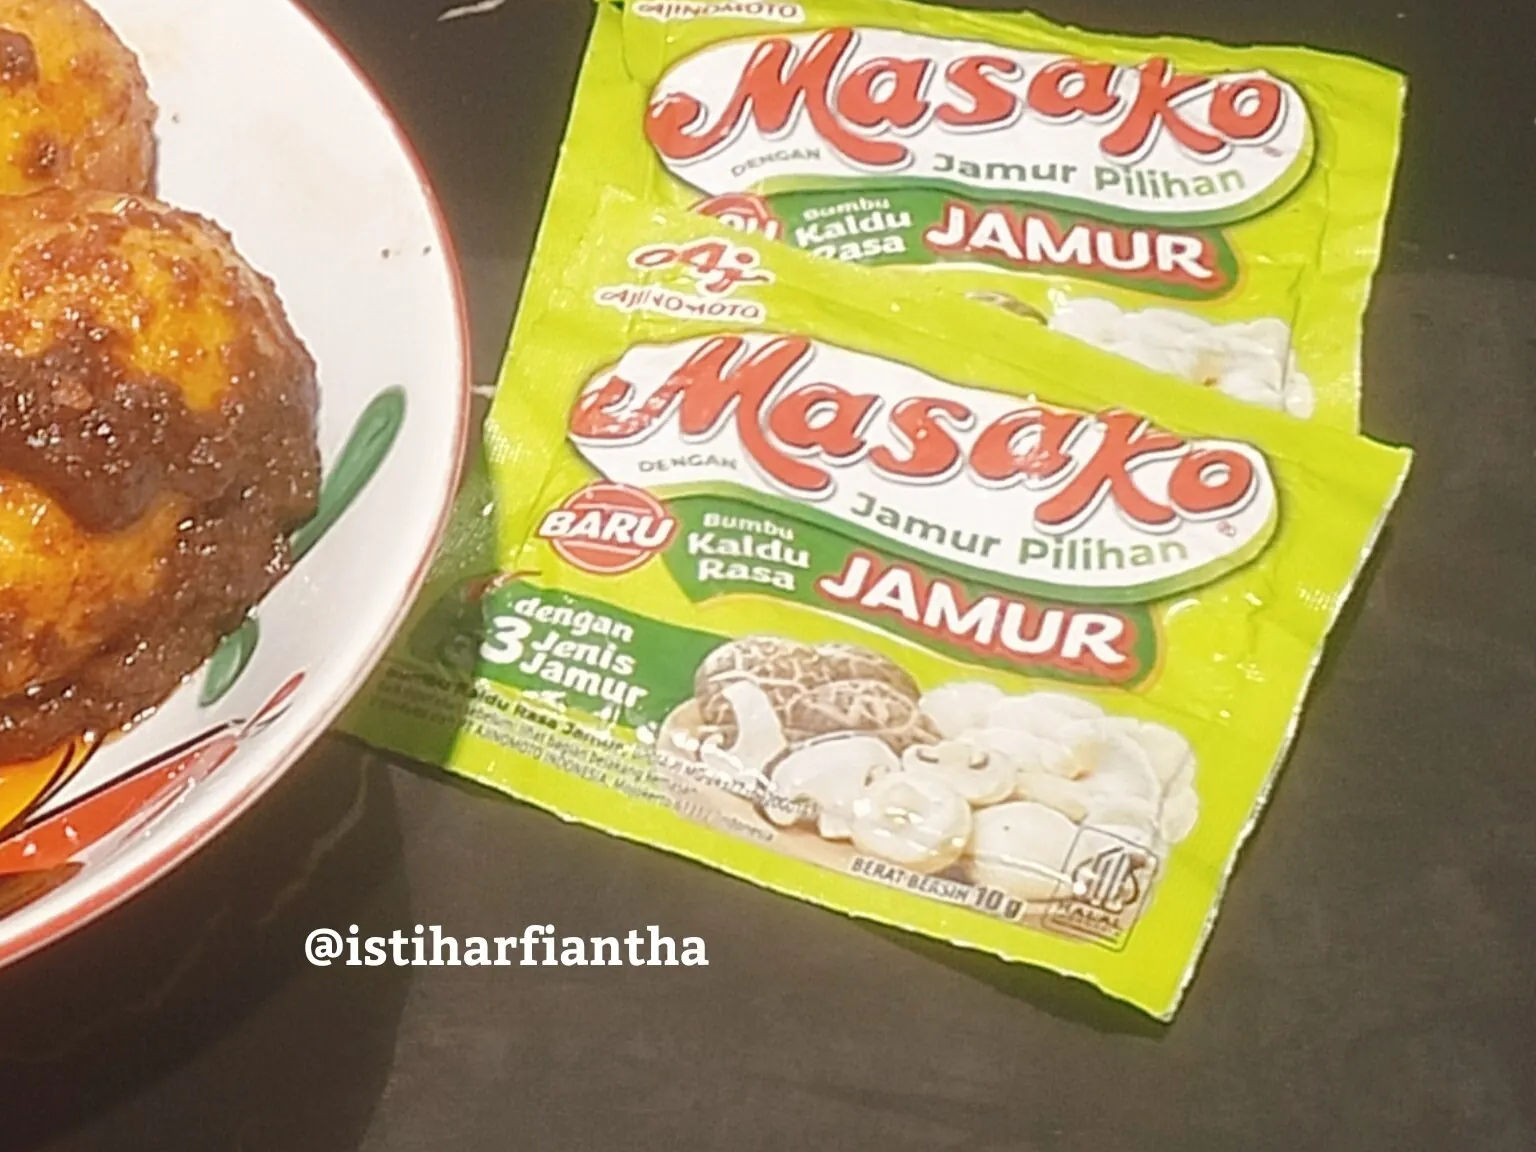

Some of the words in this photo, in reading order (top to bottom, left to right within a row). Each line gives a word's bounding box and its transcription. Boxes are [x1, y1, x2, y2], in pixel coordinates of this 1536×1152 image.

[645, 25, 1283, 167] Masako
[730, 148, 822, 178] DENGAN
[932, 151, 1078, 183] Jamur
[1094, 164, 1246, 200] Pilihan
[794, 210, 913, 247] Kaldu
[925, 204, 1214, 279] JAMUR
[600, 288, 760, 319] AJINOMOTO
[568, 334, 1255, 526] Masako
[638, 454, 739, 474] DENGAN
[538, 510, 675, 548] BARU
[687, 532, 810, 568] Kaldu
[703, 512, 795, 541] Bumbu
[849, 491, 1002, 558] Jamur
[1018, 535, 1188, 571] Pilihan
[698, 558, 796, 591] Rasa
[515, 597, 635, 643] dengan
[821, 556, 1128, 666] JAMUR
[480, 615, 532, 664] 3
[530, 630, 637, 676] Jenis
[519, 651, 649, 708] Jamur
[850, 856, 910, 886] BERAT
[972, 886, 1003, 911] 10
